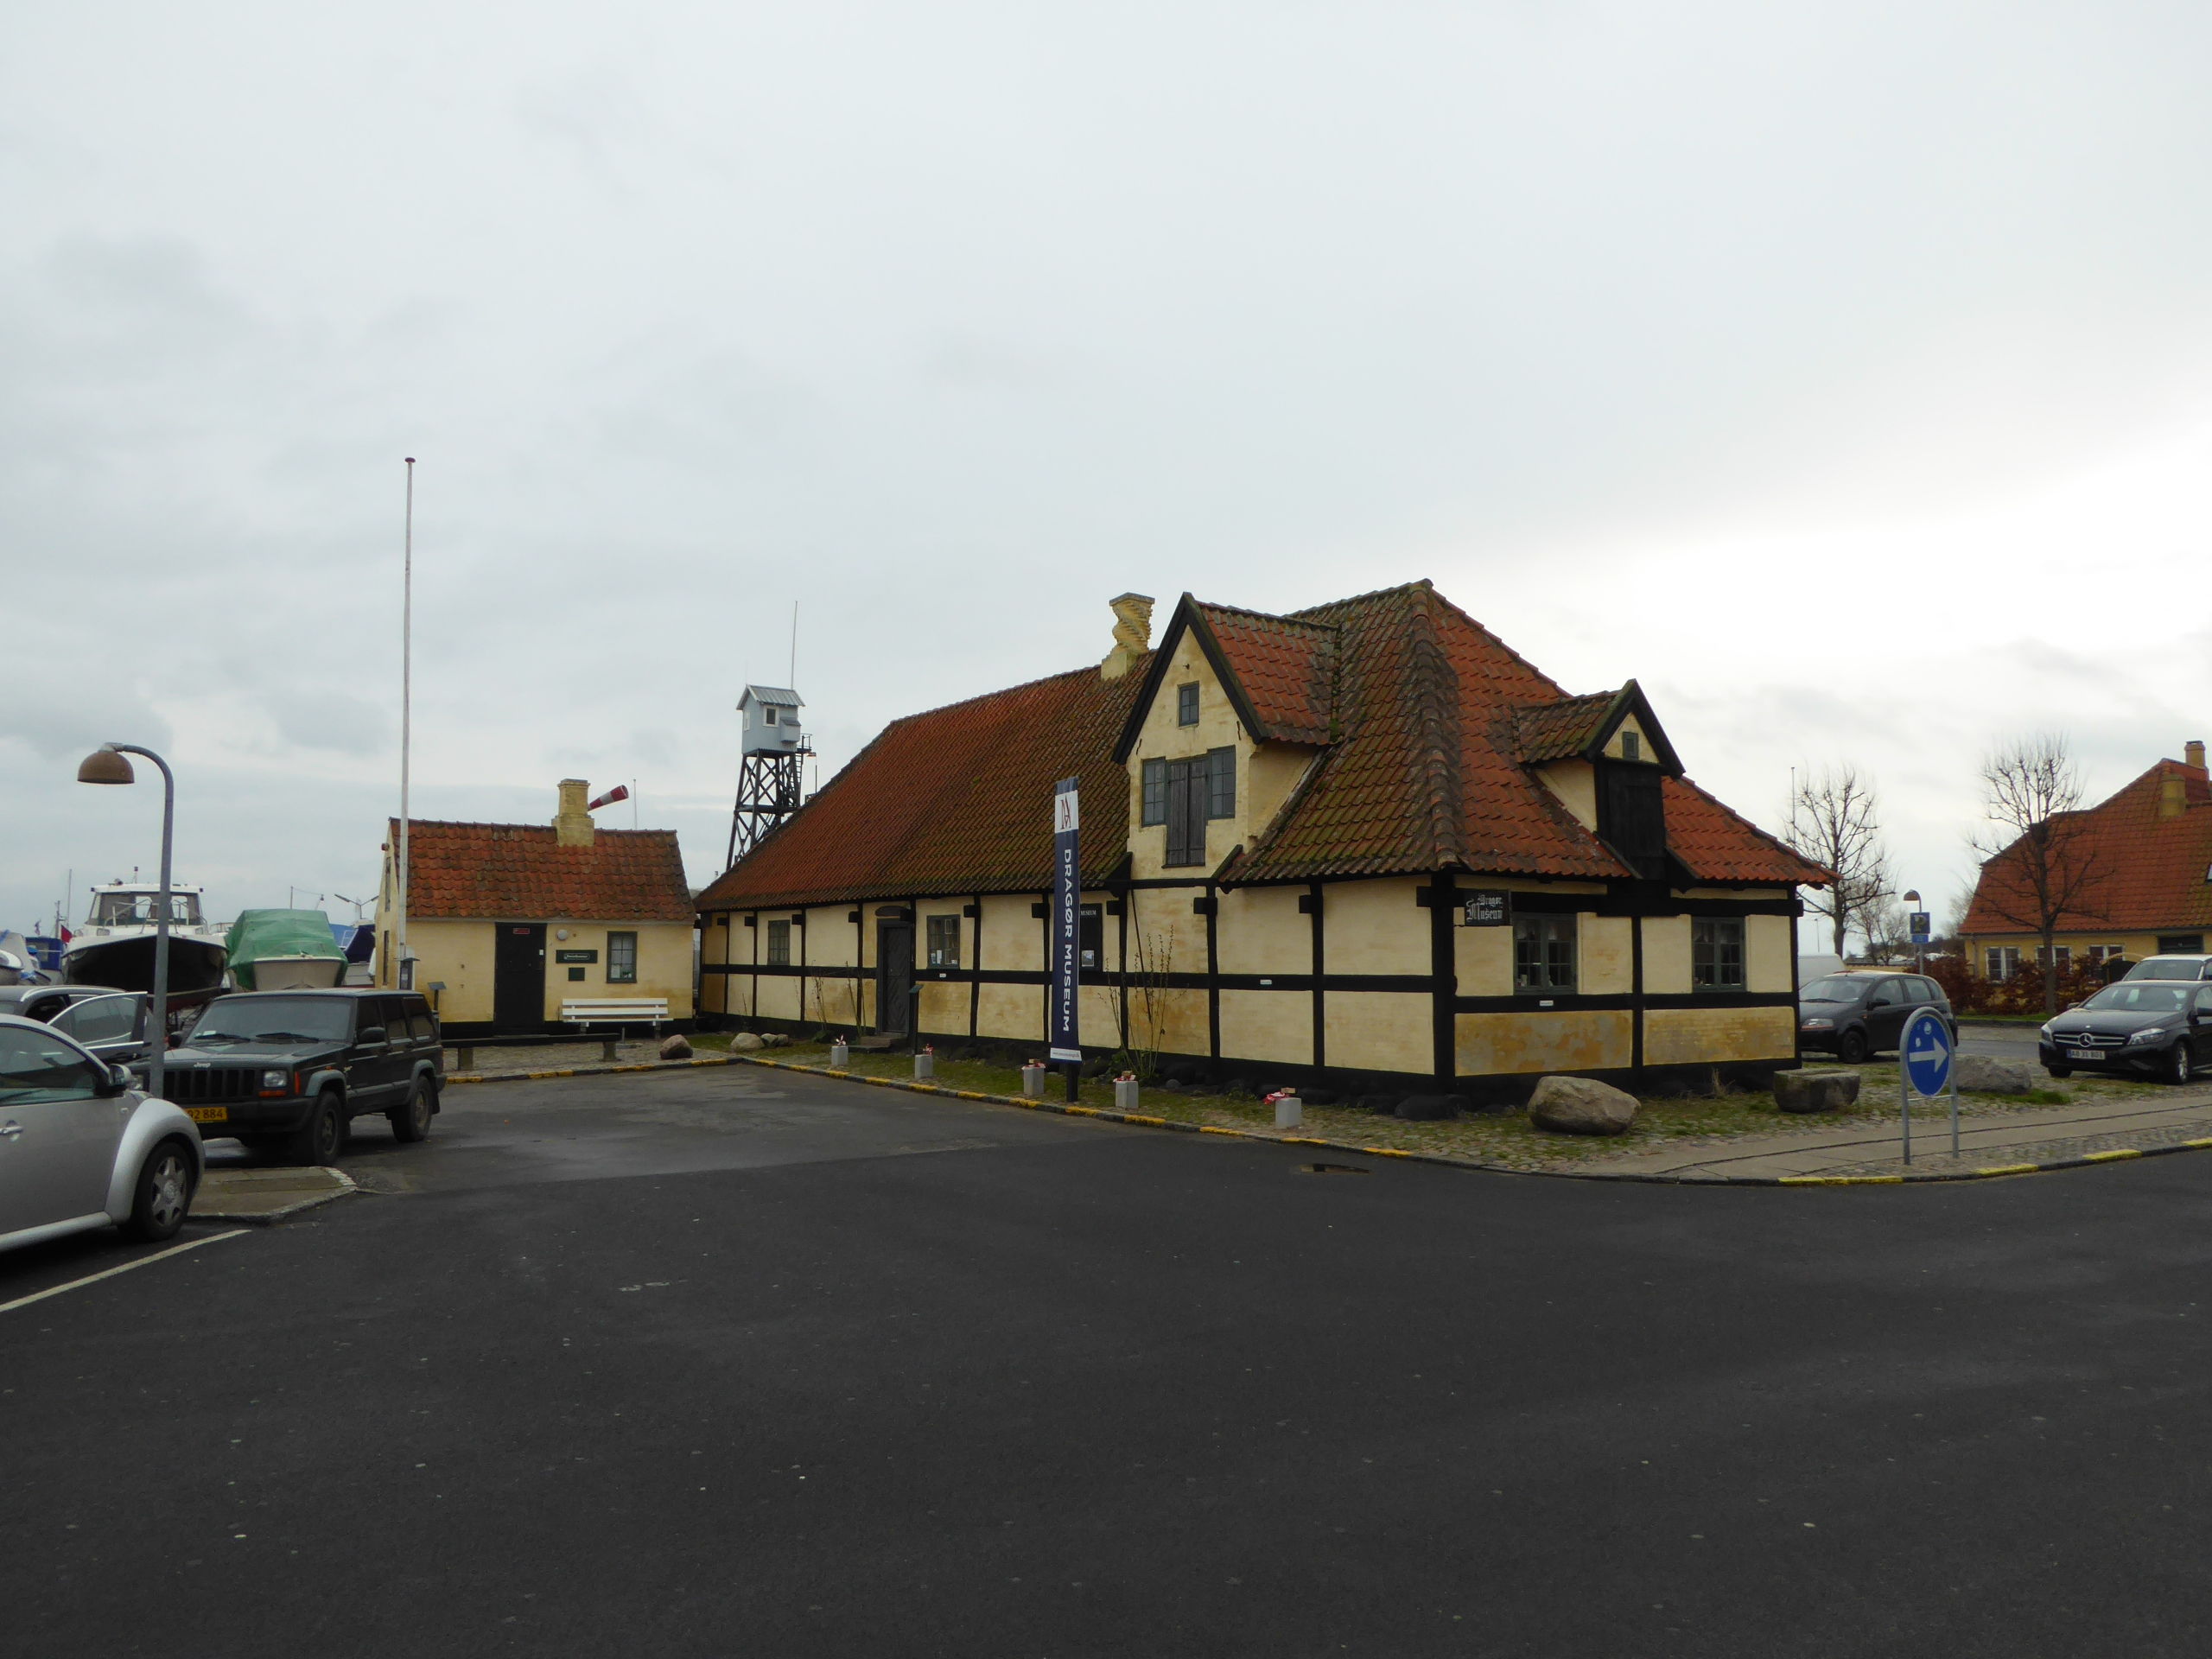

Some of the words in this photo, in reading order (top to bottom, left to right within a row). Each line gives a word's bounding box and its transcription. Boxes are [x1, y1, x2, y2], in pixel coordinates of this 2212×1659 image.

[1064, 849, 1073, 938] DRAGØR
[1914, 914, 1927, 932] P
[1063, 944, 1072, 1032] MUSEUM
[202, 1108, 224, 1119] 884
